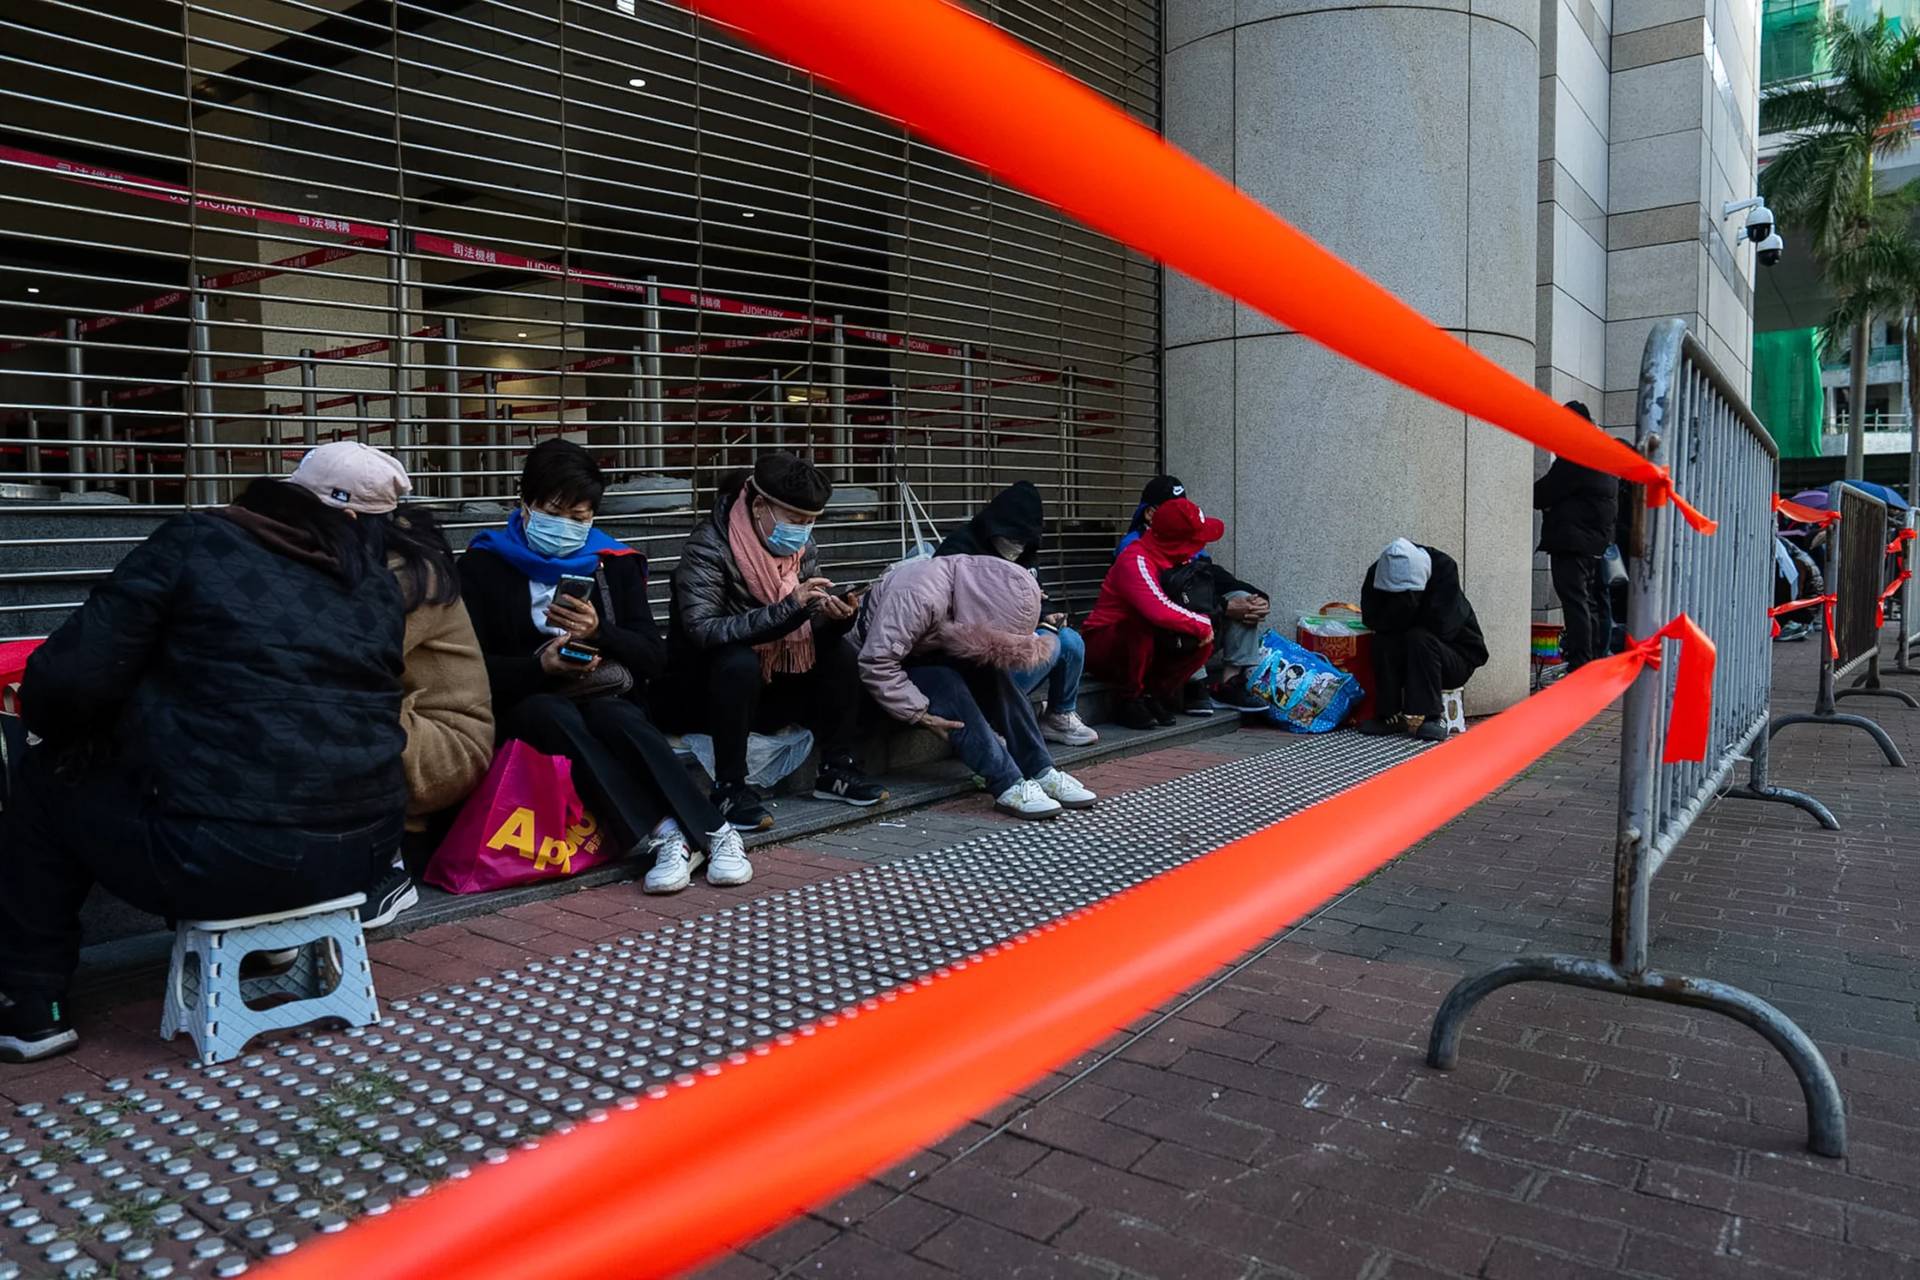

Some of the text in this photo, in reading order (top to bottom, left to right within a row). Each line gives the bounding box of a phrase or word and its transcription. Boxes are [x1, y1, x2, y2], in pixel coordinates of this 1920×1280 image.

[297, 215, 350, 233] 司法機構
[453, 242, 496, 264] 司法機構
